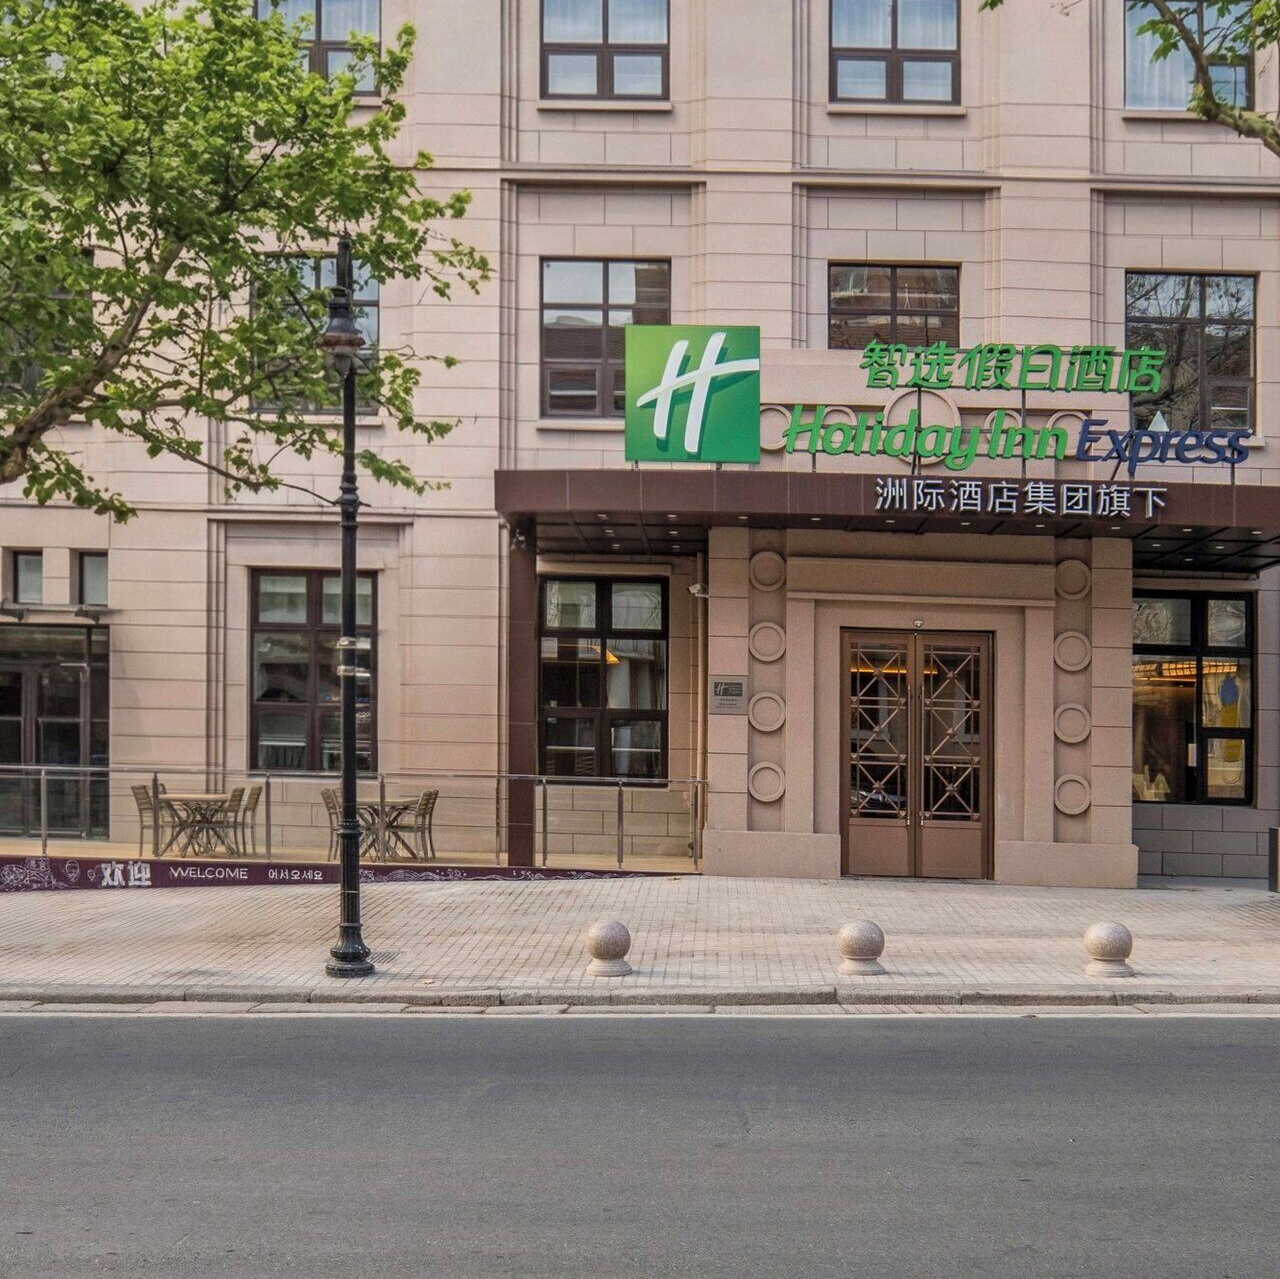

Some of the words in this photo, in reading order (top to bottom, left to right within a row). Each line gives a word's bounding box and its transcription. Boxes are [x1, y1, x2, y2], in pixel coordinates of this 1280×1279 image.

[859, 339, 1167, 394] 智选假日酒店
[782, 402, 977, 471] Holiday
[988, 407, 1069, 461] Inn
[1074, 418, 1255, 478] Express
[874, 476, 1168, 518] 洲际酒店集团旗下
[101, 860, 152, 887] 欢迎
[170, 866, 248, 880] WELCOME
[268, 869, 323, 881] 어서오세요
